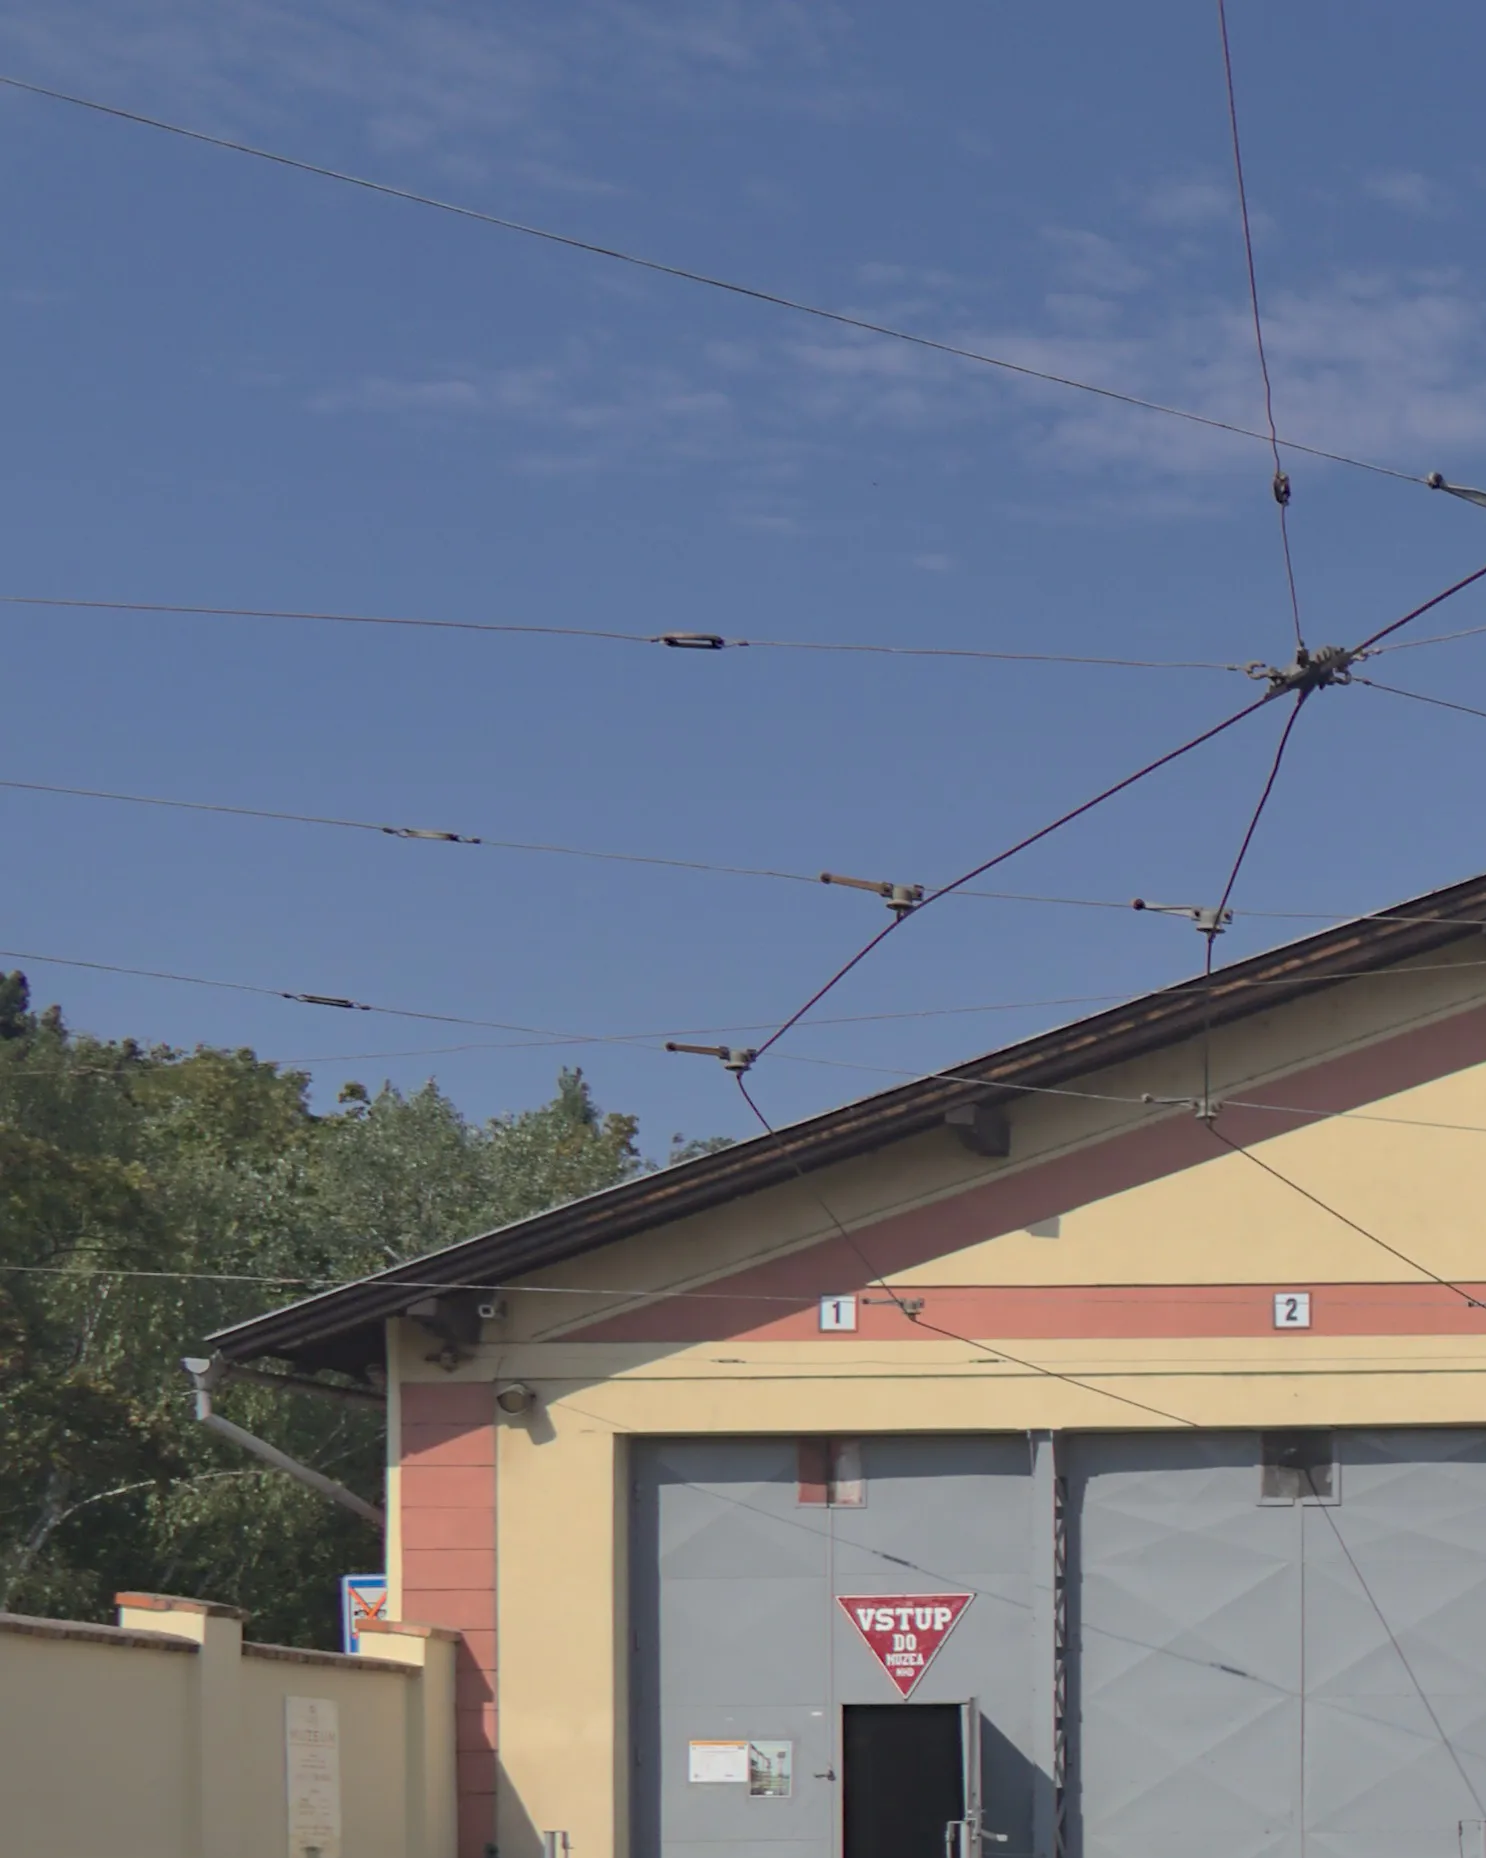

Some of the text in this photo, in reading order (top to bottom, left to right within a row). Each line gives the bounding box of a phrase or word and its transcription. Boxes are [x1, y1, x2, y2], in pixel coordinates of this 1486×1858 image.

[832, 1302, 841, 1324] 1
[1285, 1298, 1298, 1321] 2
[856, 1607, 952, 1631] VSTUP
[892, 1633, 917, 1651] DO
[885, 1653, 924, 1666] MUZEA
